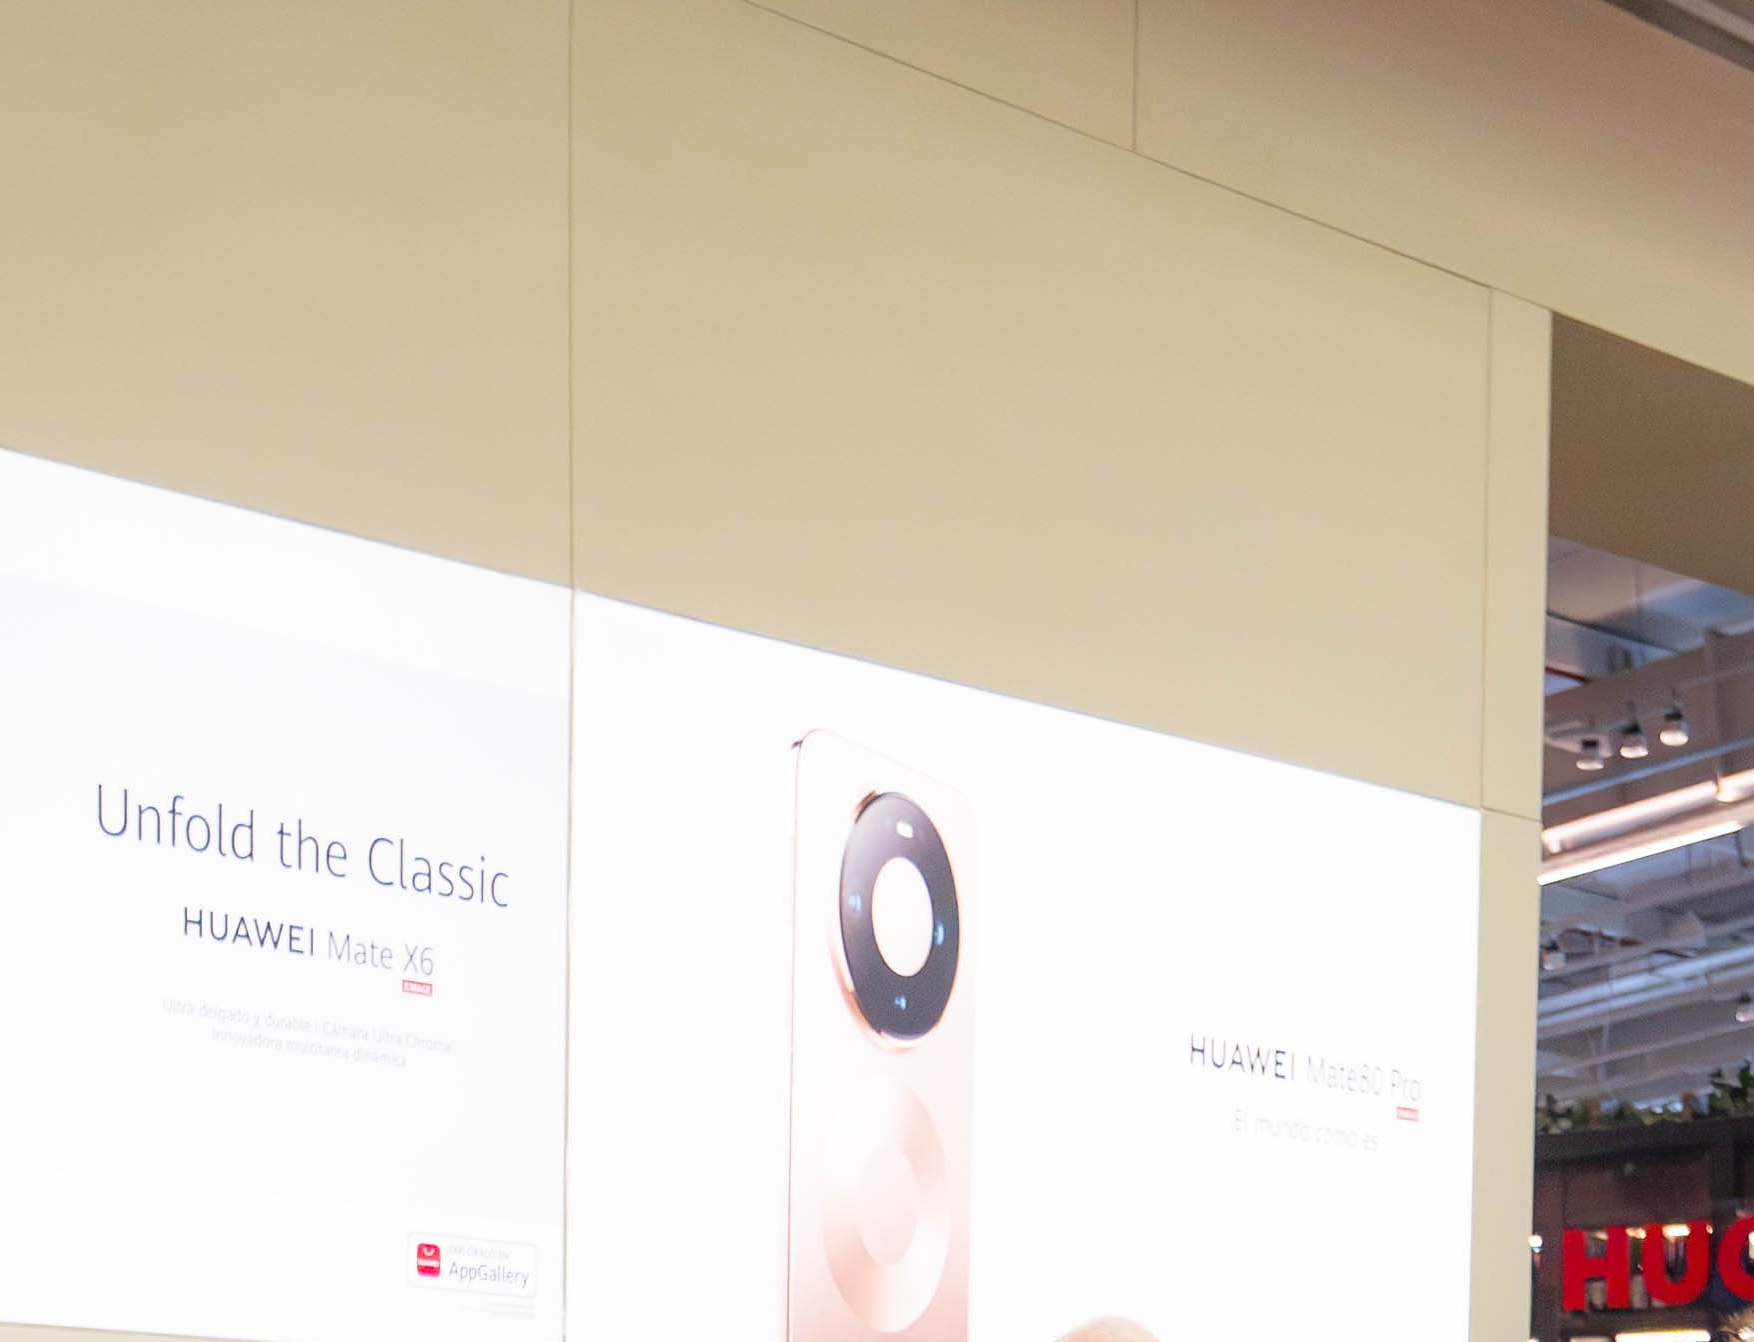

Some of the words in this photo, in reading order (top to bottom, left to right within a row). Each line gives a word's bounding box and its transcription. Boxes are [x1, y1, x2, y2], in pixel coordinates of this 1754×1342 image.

[97, 783, 255, 862] Unfold
[277, 818, 348, 879] the
[367, 837, 510, 909] Classic
[183, 907, 315, 957] HUAWEI
[327, 930, 393, 972] Mate
[402, 943, 435, 977] X6
[1189, 1032, 1296, 1081] HUAWEI
[1391, 1067, 1423, 1103] Pro
[449, 1261, 530, 1289] AppGallery
